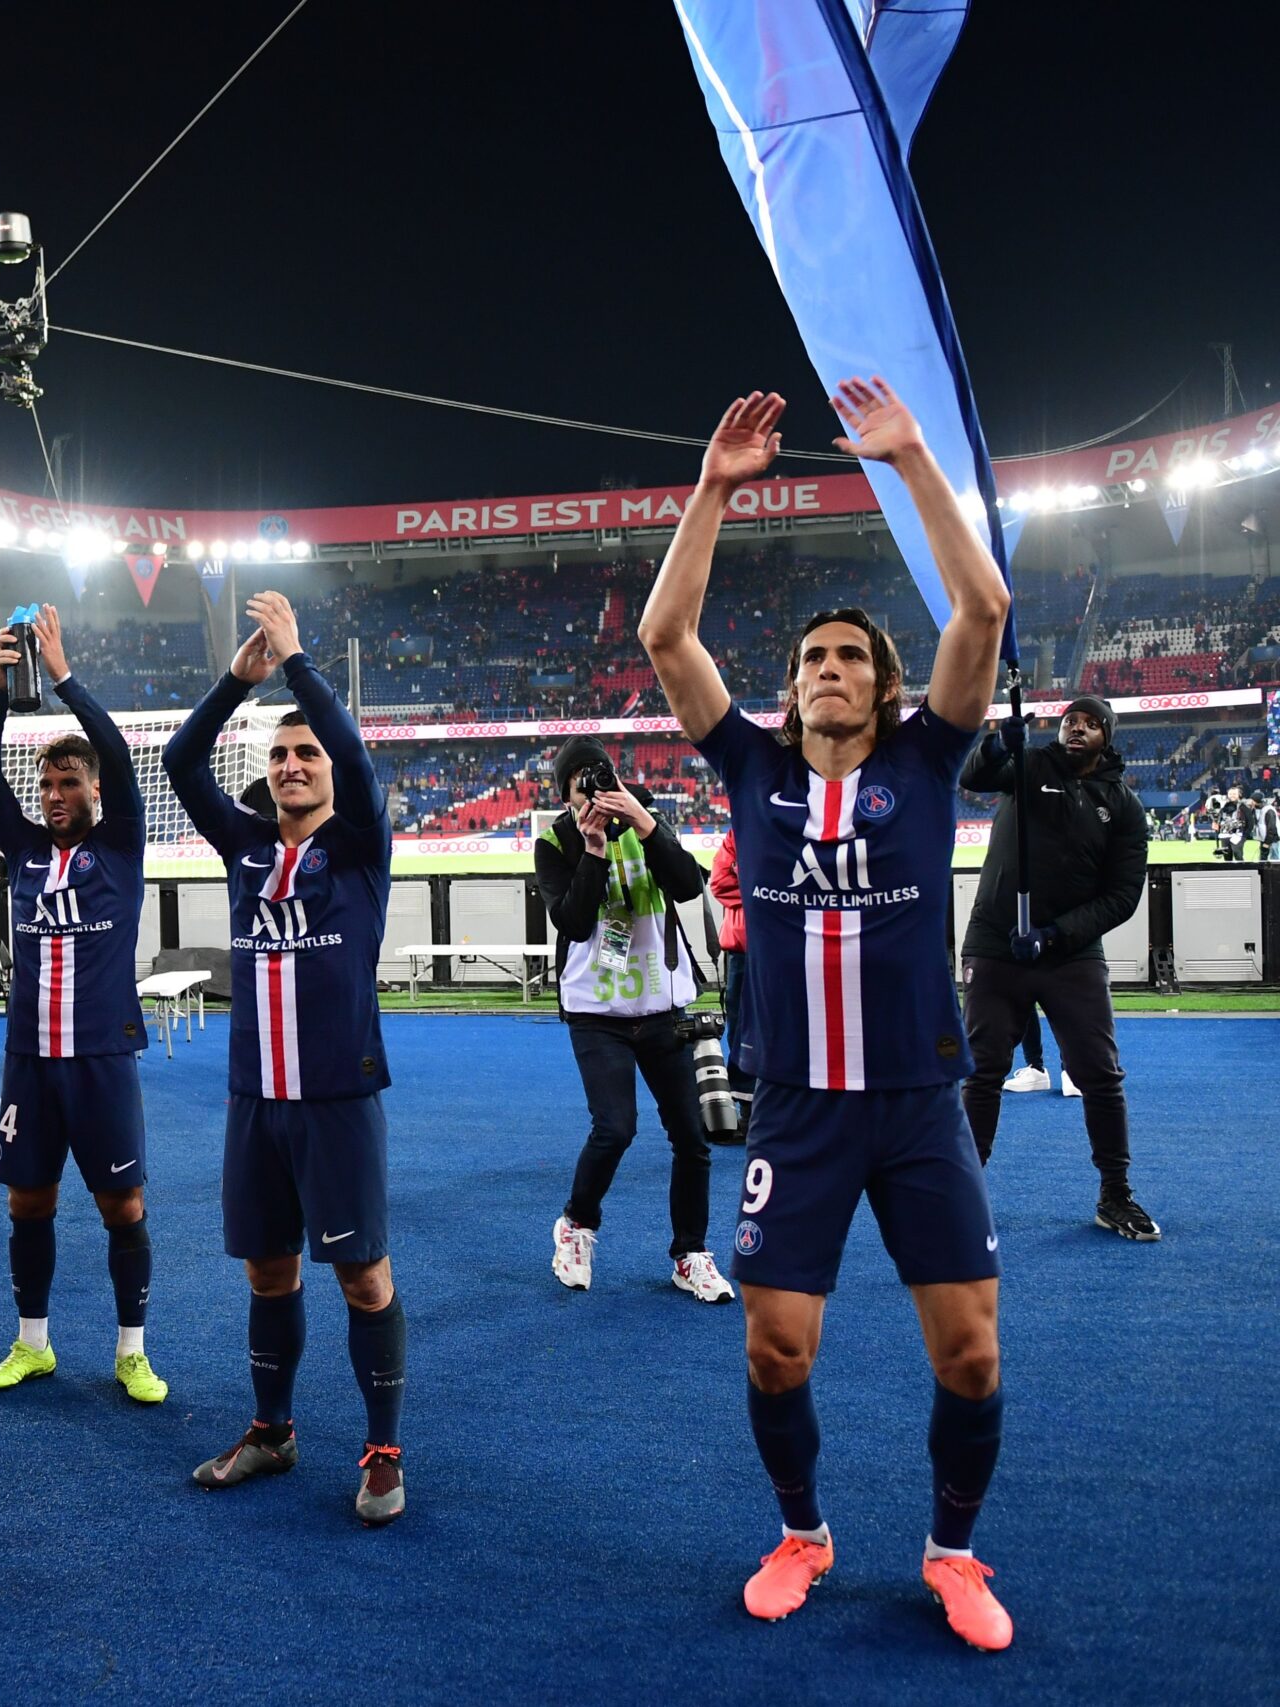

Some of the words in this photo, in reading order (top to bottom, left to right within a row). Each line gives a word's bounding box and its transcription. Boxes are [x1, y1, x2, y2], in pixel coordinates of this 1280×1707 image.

[1105, 427, 1232, 478] PARIS
[396, 503, 518, 535] PARIS
[530, 499, 607, 527] EST
[622, 483, 820, 521] MAQUE
[1139, 694, 1209, 710] ooredoo
[447, 725, 508, 737] ooredoo
[539, 721, 601, 734] ooredoo
[633, 717, 683, 731] oored
[418, 841, 489, 854] ooredoo
[752, 885, 800, 905] ACCOR
[804, 894, 838, 907] LIVE
[842, 885, 920, 908] LIMITLESS
[15, 922, 38, 934] ACCOR
[231, 937, 254, 950] ACCOR
[255, 940, 281, 950] LIVE
[281, 933, 343, 951] LIMITLESS
[645, 952, 662, 996] PHOTO
[742, 1158, 773, 1214] 9
